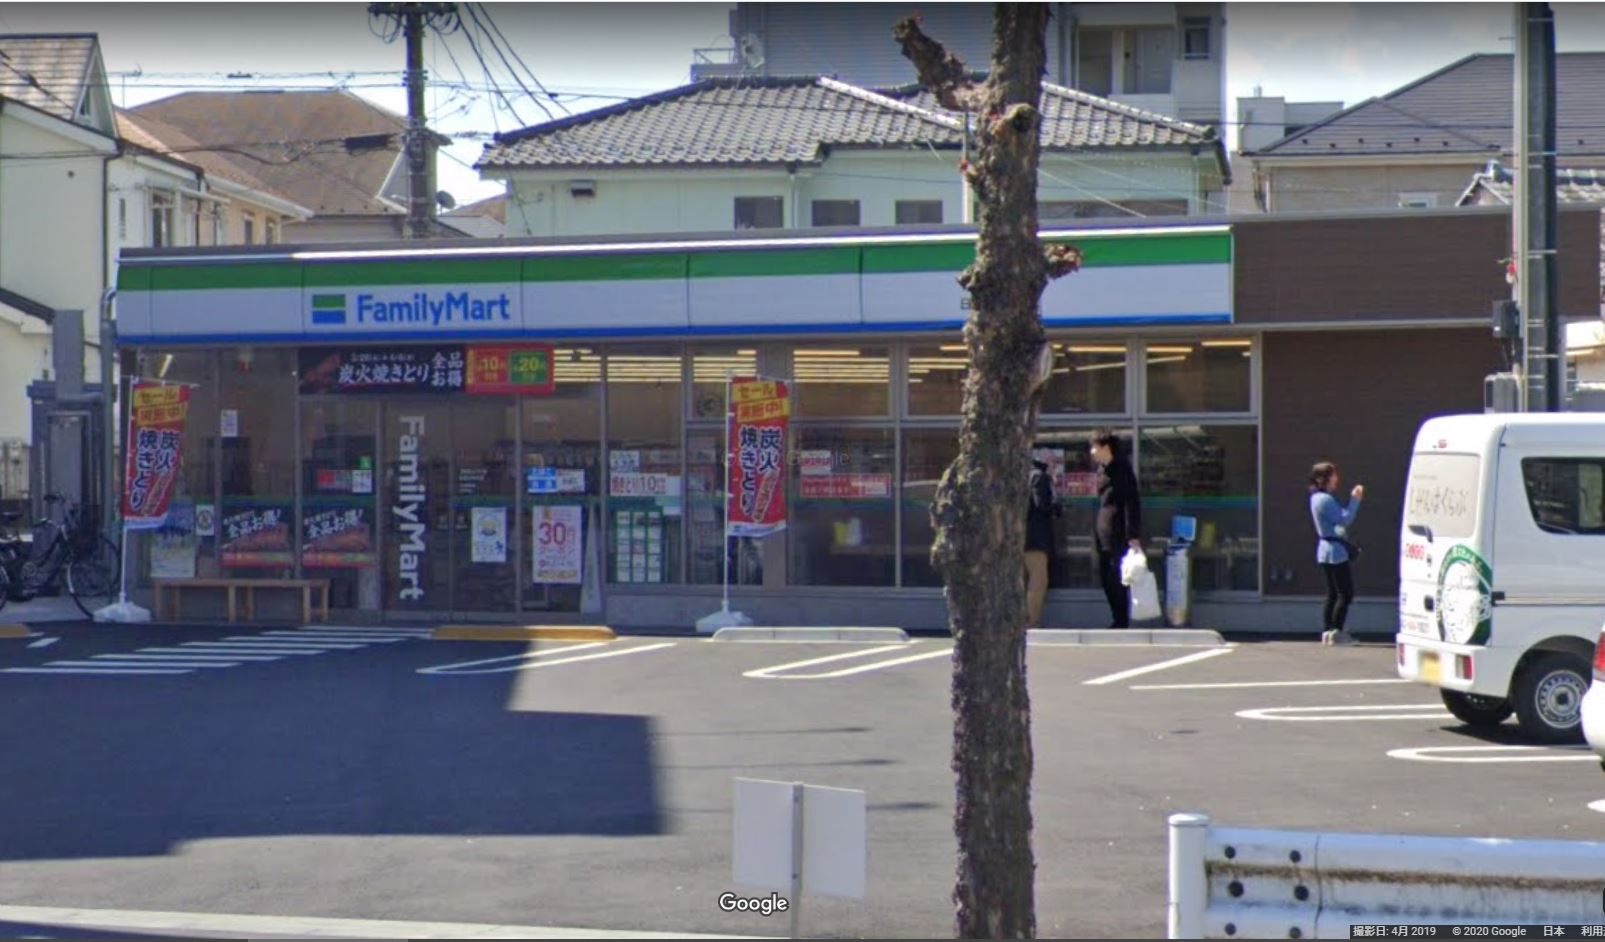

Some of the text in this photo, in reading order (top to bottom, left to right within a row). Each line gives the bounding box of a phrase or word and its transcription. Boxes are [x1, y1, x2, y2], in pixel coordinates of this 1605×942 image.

[357, 292, 510, 326] FamilyMart
[338, 362, 430, 385] 炭火焼きとり
[430, 369, 463, 387] お得
[431, 351, 463, 369] 全品
[131, 430, 157, 509] 焼きとり
[156, 431, 180, 470] 炭火
[759, 428, 782, 472] 炭火
[740, 426, 758, 516] 焼きとり
[392, 415, 425, 600] FamilyMart
